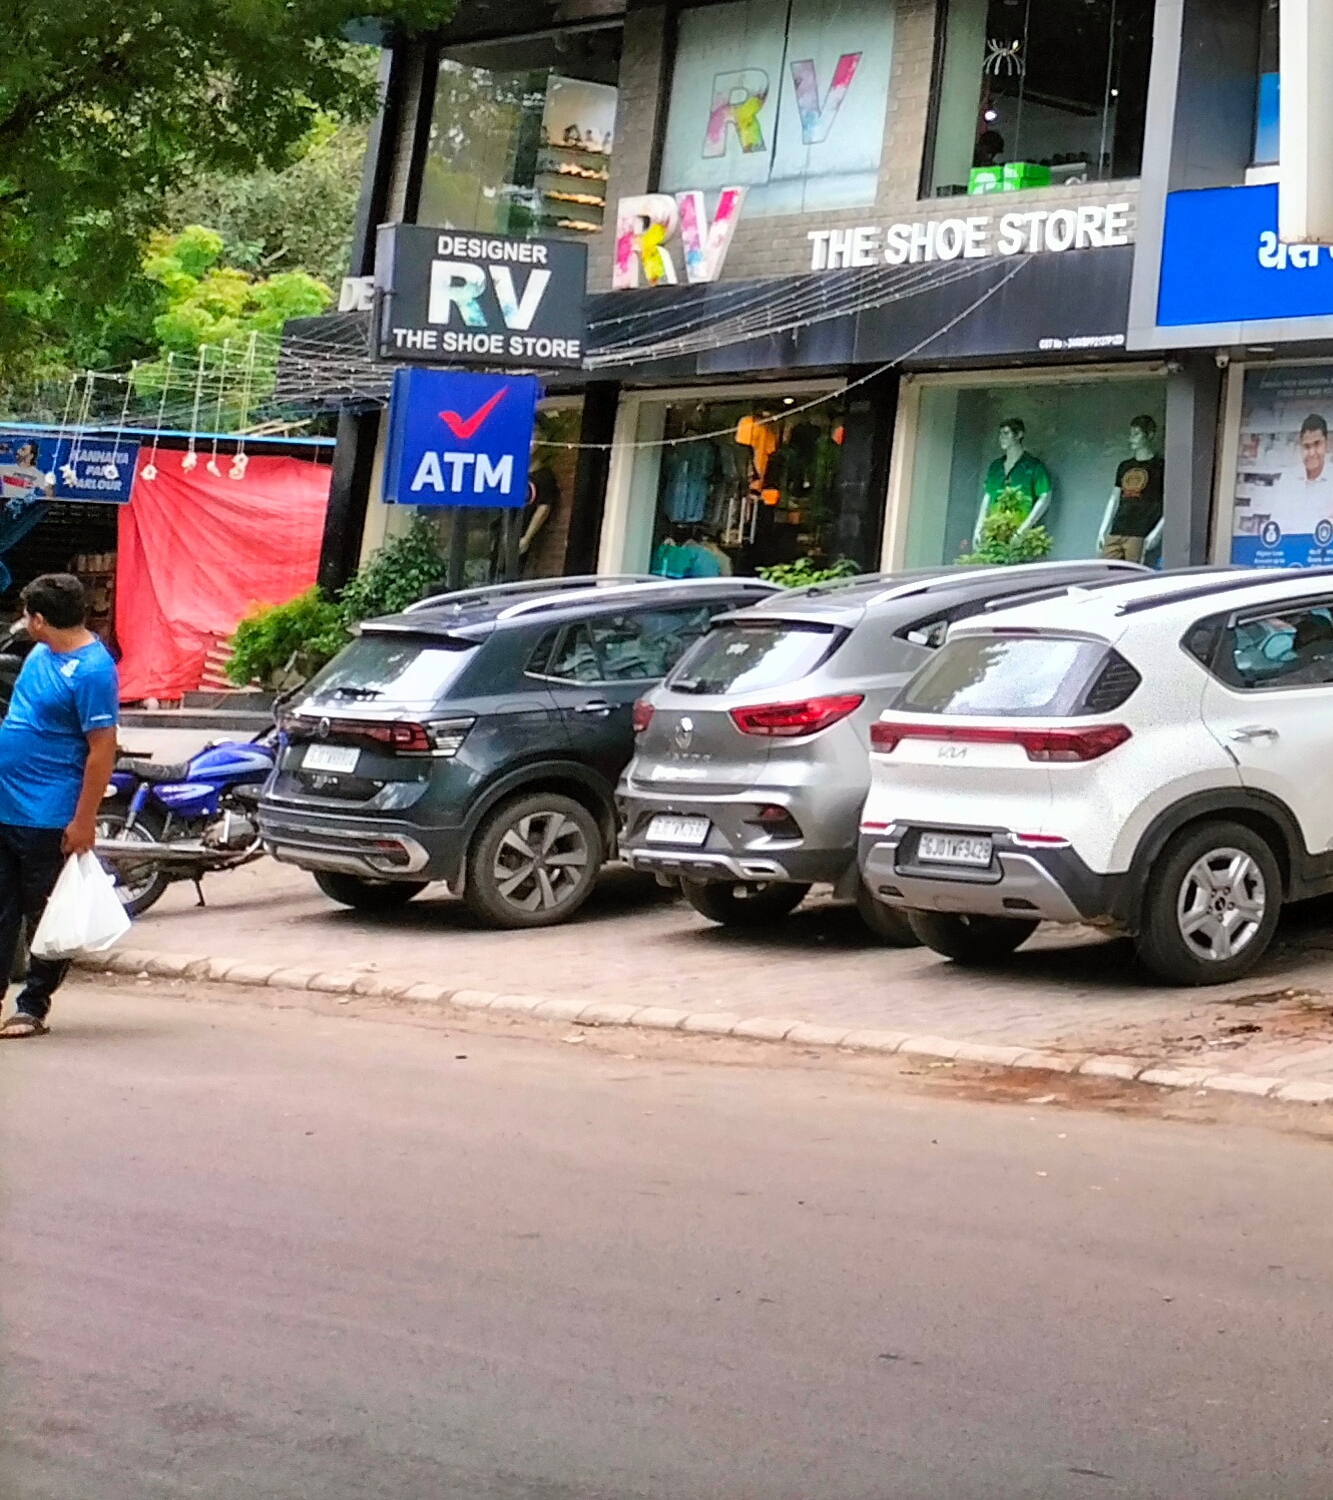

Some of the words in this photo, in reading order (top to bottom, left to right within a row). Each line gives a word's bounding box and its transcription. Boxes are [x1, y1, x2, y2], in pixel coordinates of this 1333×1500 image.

[701, 50, 864, 160] RV
[437, 235, 549, 265] DESIGNER
[612, 186, 749, 289] RV
[807, 225, 879, 272] THE
[882, 214, 989, 266] SHOE
[996, 201, 1132, 256] STORE
[427, 258, 553, 332] RV
[393, 327, 440, 353] THE
[441, 329, 505, 356] SHOE
[507, 332, 581, 359] STORE
[410, 450, 514, 495] ATM
